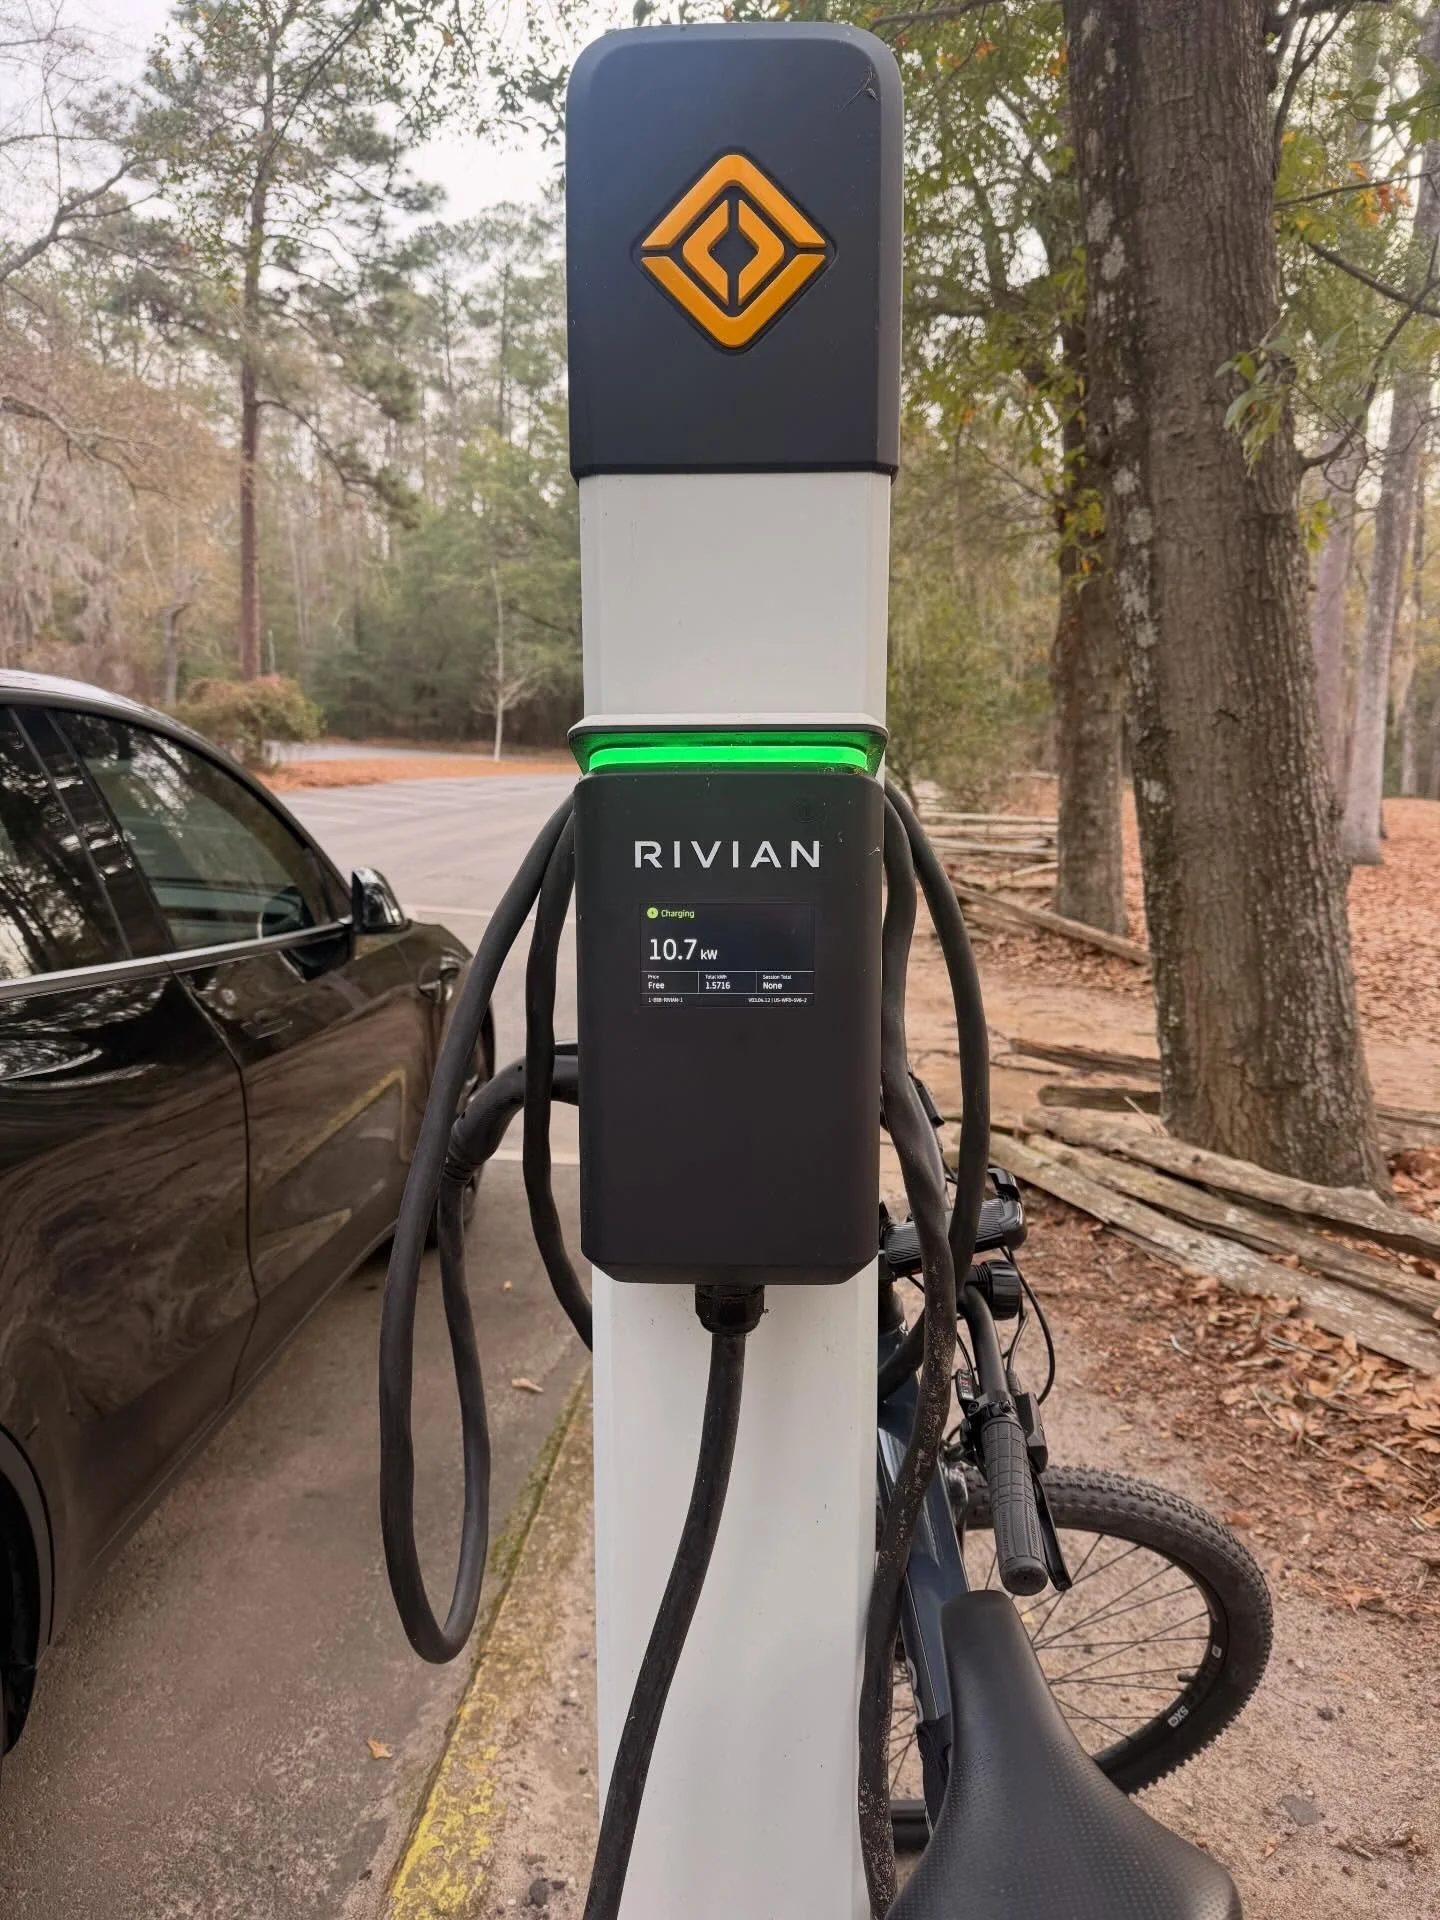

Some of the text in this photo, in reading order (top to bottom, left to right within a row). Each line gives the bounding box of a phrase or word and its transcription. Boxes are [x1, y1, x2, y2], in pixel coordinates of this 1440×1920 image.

[634, 840, 820, 868] RIVIAN
[661, 908, 695, 919] Charging
[649, 938, 718, 961] 10.7 kW
[647, 981, 665, 990] Free
[705, 981, 731, 990] 1.5716
[762, 981, 783, 990] None
